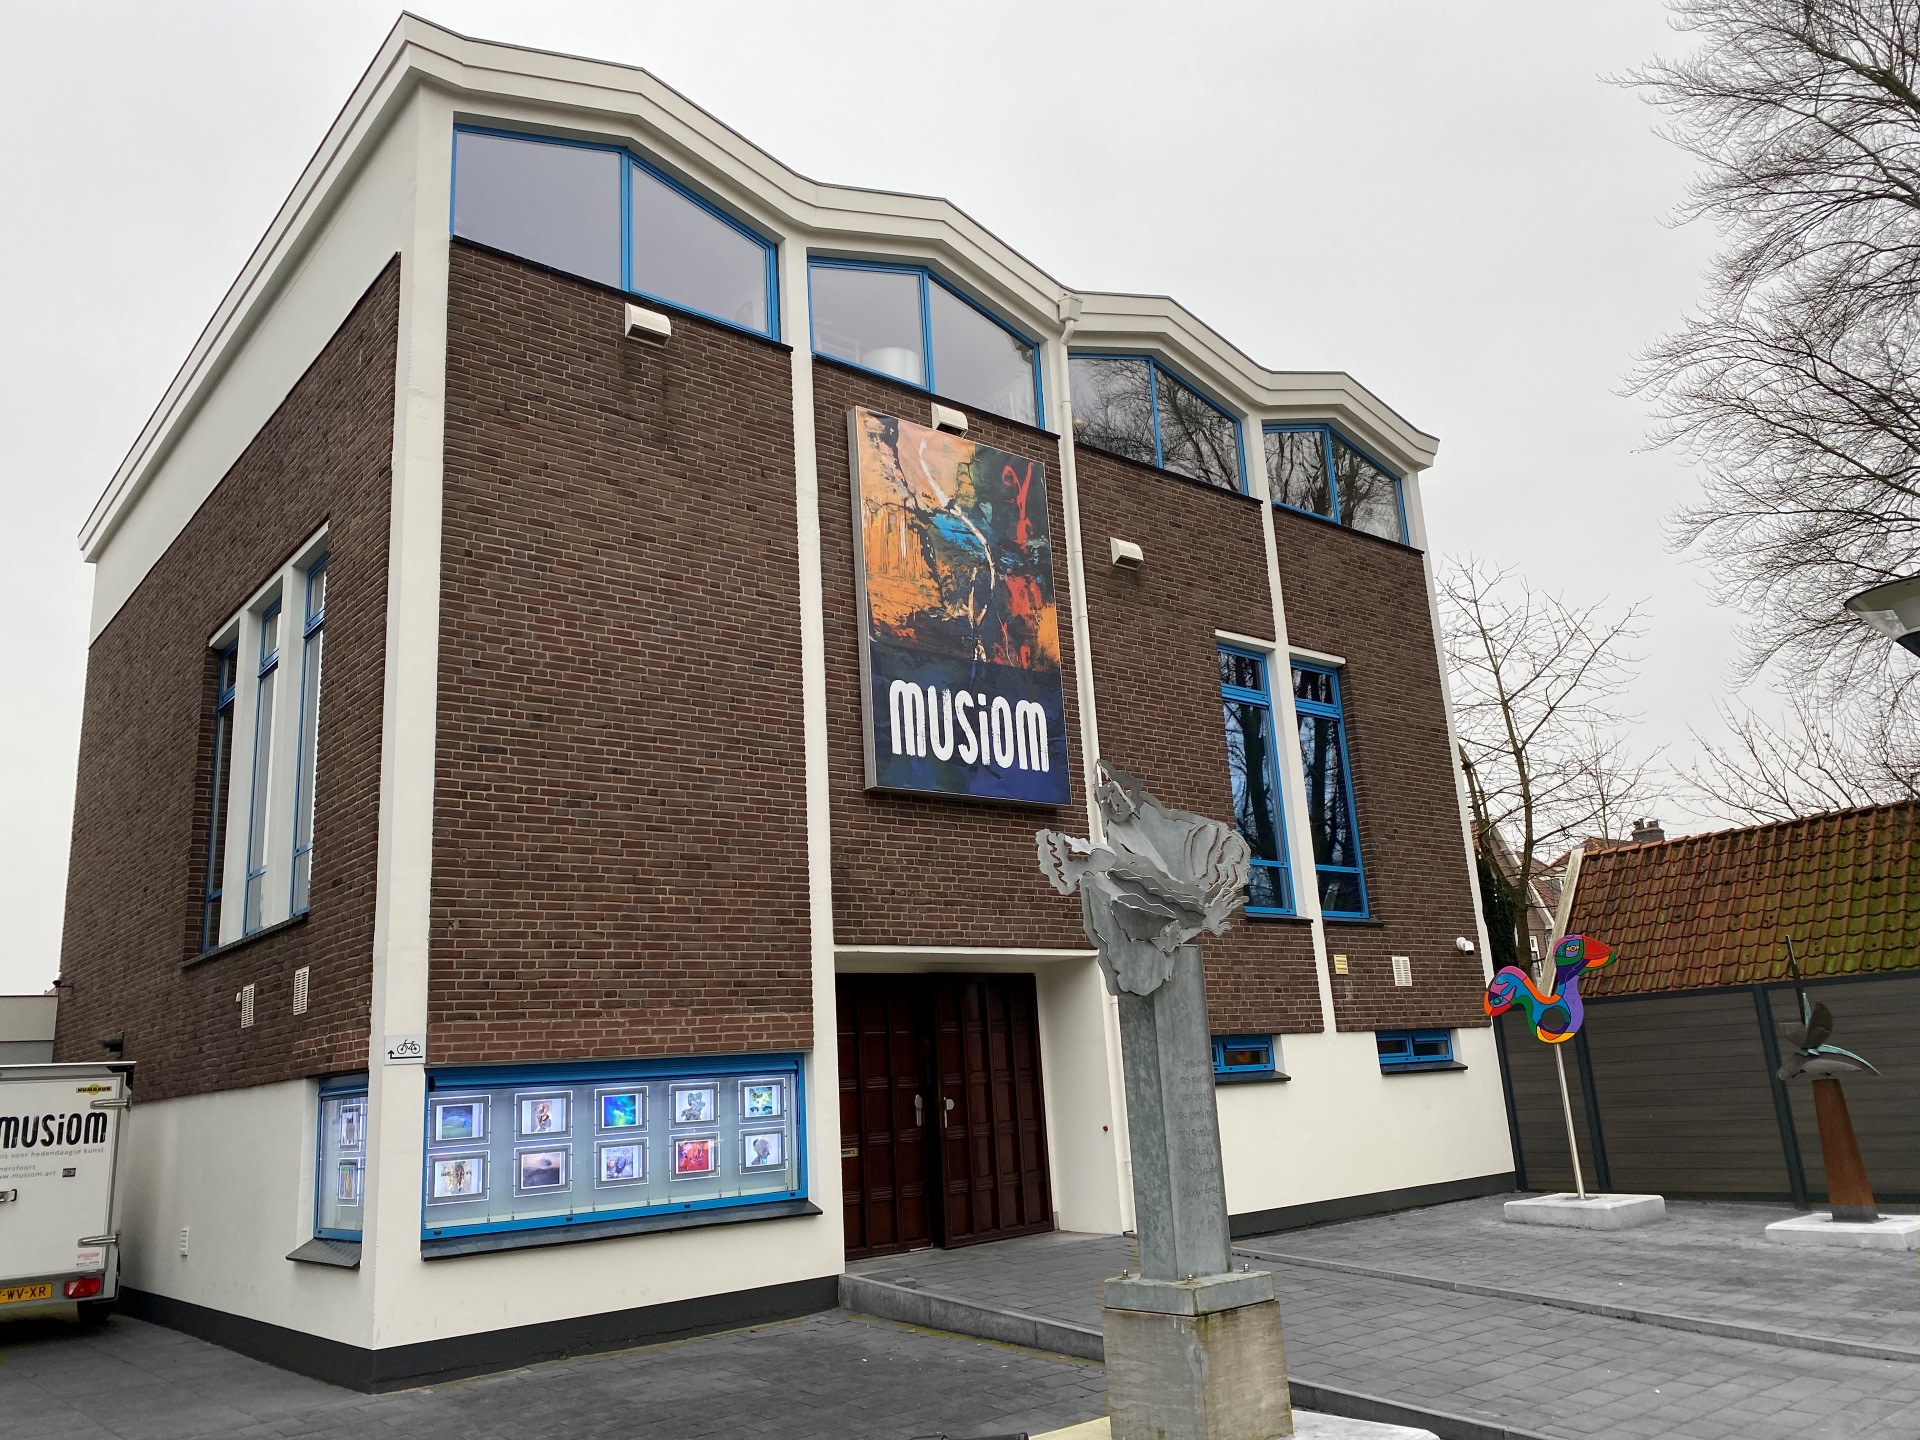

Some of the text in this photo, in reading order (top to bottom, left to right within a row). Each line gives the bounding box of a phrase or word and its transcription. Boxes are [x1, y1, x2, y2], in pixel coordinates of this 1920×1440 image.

[31, 1148, 82, 1157] hedendaagse
[84, 1147, 104, 1155] kunst
[0, 1286, 46, 1301] -WV-XR
